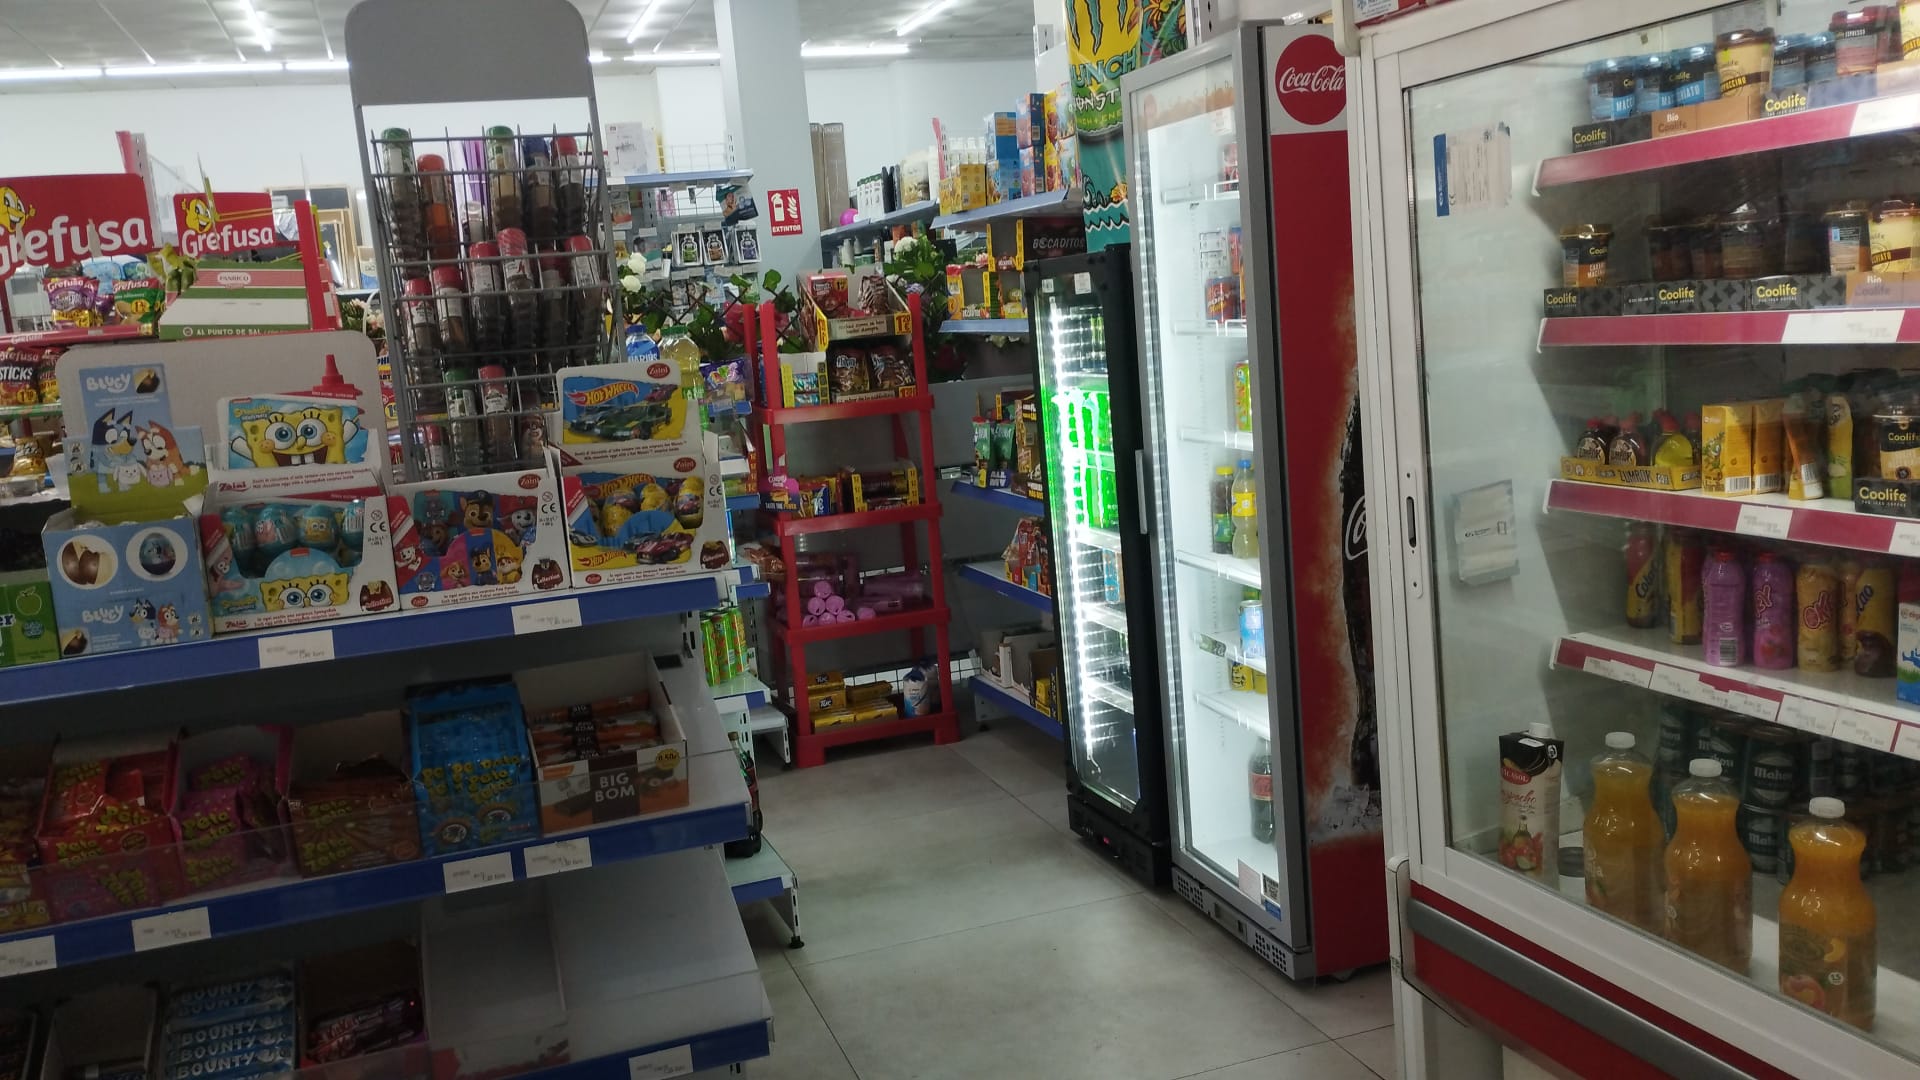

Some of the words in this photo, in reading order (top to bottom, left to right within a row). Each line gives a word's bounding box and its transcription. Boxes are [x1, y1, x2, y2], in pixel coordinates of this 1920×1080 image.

[1765, 94, 1806, 112] Coolife
[1667, 113, 1679, 122] Bio
[1574, 129, 1606, 144] Coolife
[772, 225, 801, 233] EXTINTOR
[181, 224, 275, 260] Grefusa
[1546, 292, 1576, 304] Coolife
[1659, 287, 1695, 300] Coolife
[1756, 284, 1797, 297] Coolife
[197, 328, 206, 336] AL
[208, 327, 234, 336] PUNTO
[236, 327, 247, 335] DE
[585, 391, 607, 406] HOT
[603, 381, 636, 401] WHEELS
[219, 481, 247, 492] Zaini
[1859, 486, 1907, 502] Coolife
[599, 771, 630, 790] BIG
[594, 784, 636, 803] BOM
[183, 1020, 256, 1046] BOUNTY
[181, 1035, 255, 1062] BOUNTY
[177, 1052, 252, 1079] BOUNTY
